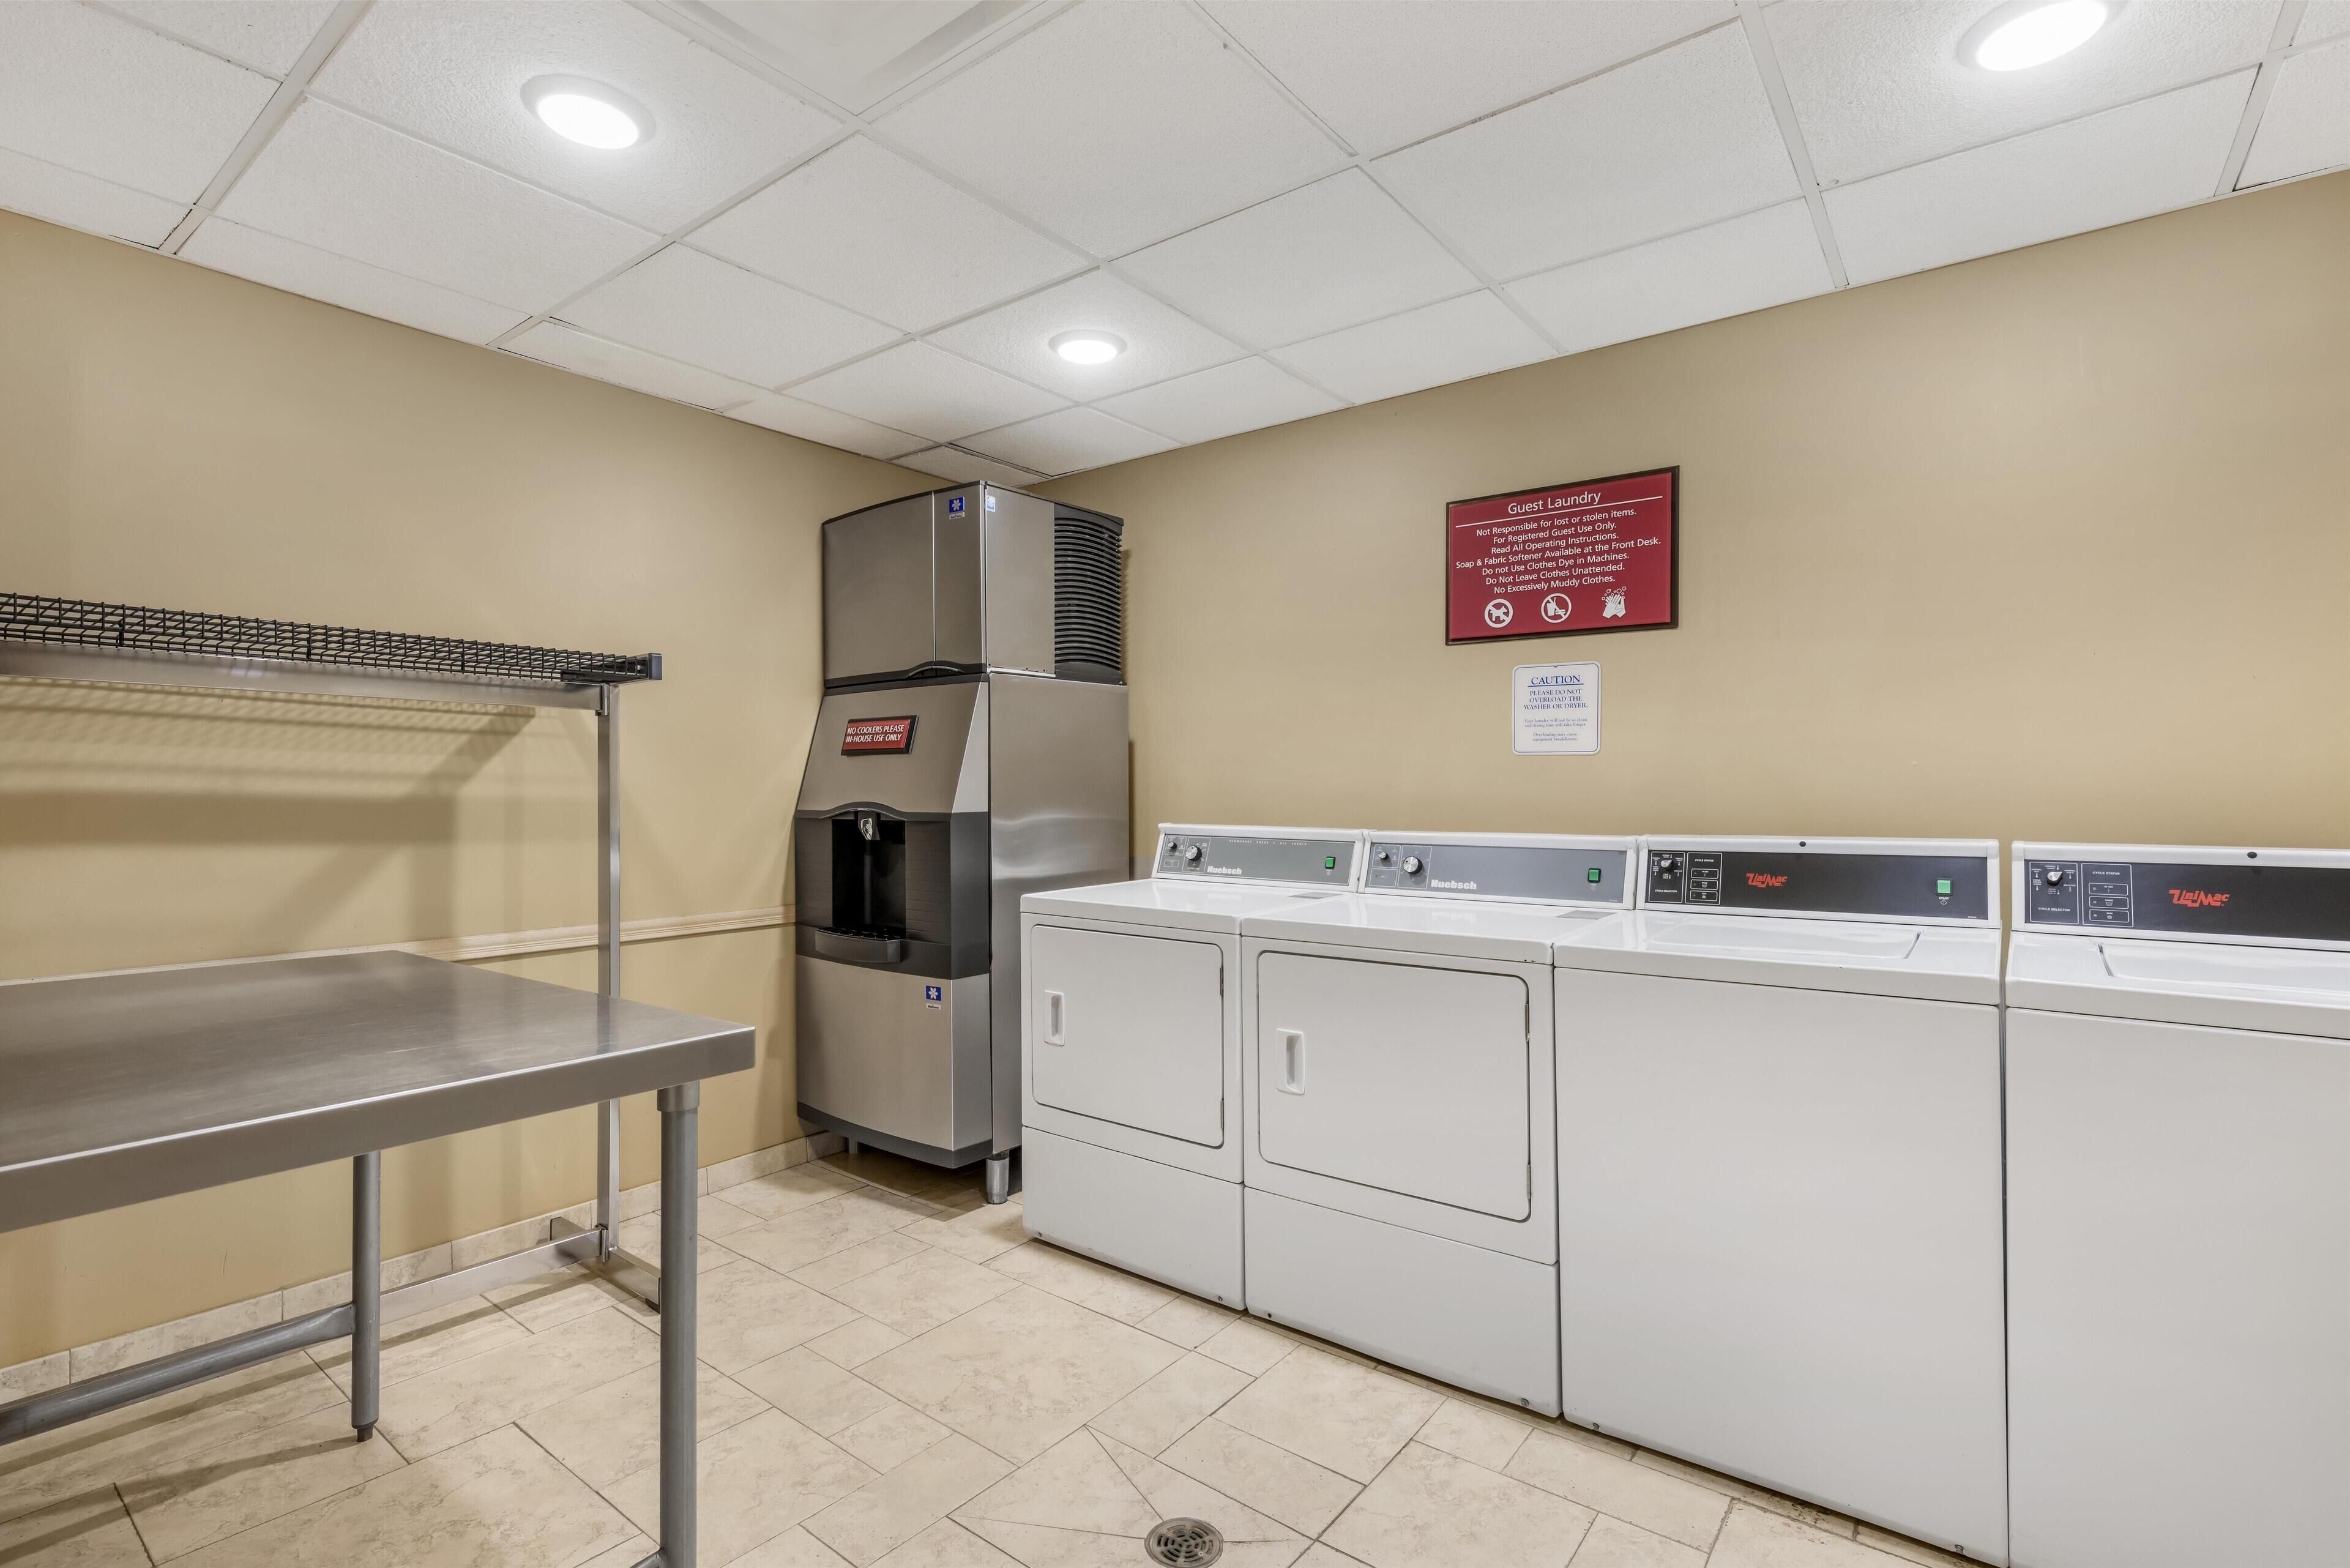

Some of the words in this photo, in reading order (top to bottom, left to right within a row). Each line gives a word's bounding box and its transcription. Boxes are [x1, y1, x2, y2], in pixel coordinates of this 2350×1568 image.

[1508, 499, 1543, 514] Guest
[1548, 491, 1601, 509] Laundry
[1493, 521, 1538, 534] Responsible
[1583, 512, 1608, 522] stolen
[1611, 509, 1636, 518] items.
[1508, 530, 1549, 543] Registered
[1551, 527, 1575, 537] Guest
[1578, 525, 1592, 533] Use
[1595, 521, 1617, 531] Only.
[1485, 556, 1507, 566] Fabric
[1509, 553, 1542, 562] Softener
[1544, 547, 1581, 558] Available
[1595, 543, 1609, 552] the
[1611, 540, 1635, 550] Front
[1637, 537, 1661, 547] Desk.
[1491, 545, 1510, 554] Read
[1512, 543, 1523, 552] All
[1525, 539, 1566, 551] Operating
[1569, 532, 1619, 544] Instructions.
[1527, 560, 1556, 570] Clothes
[1559, 558, 1575, 568] Dye
[1587, 553, 1629, 563] Machines.
[1515, 572, 1537, 581] Leave
[1540, 569, 1570, 579] Clothes
[1572, 562, 1625, 575] Unattended.
[1507, 581, 1548, 592] Excessively
[1551, 578, 1580, 588] Muddy
[1582, 575, 1616, 584] Clothes.
[1531, 675, 1580, 685] CAUTION
[1207, 865, 1242, 875] Huebsch
[1431, 879, 1477, 890] Huebsch
